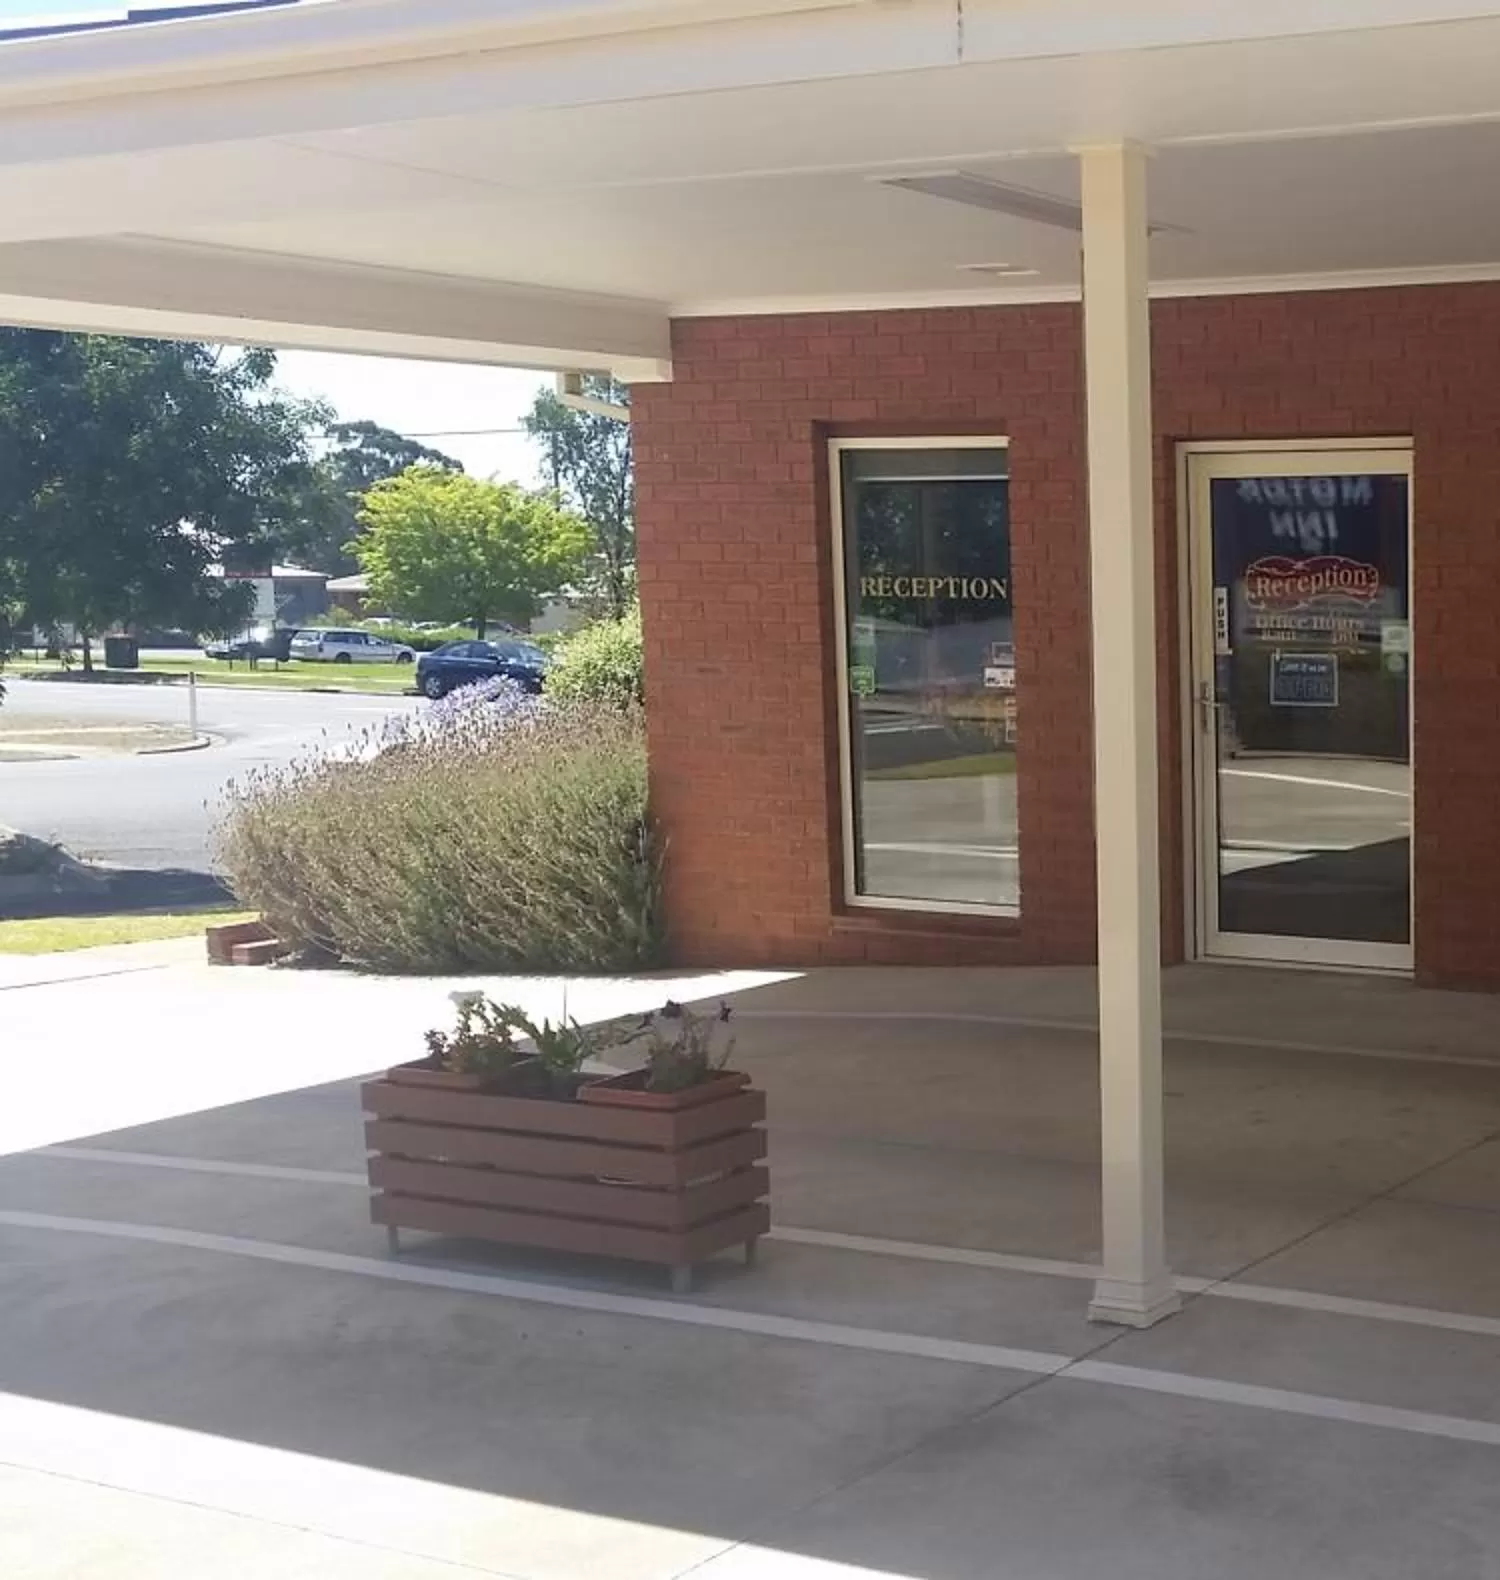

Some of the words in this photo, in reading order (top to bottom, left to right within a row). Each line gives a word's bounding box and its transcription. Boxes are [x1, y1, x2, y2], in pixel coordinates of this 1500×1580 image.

[859, 575, 1008, 599] RECEPTION
[1256, 565, 1368, 598] Reception
[1216, 596, 1226, 641] PUSH
